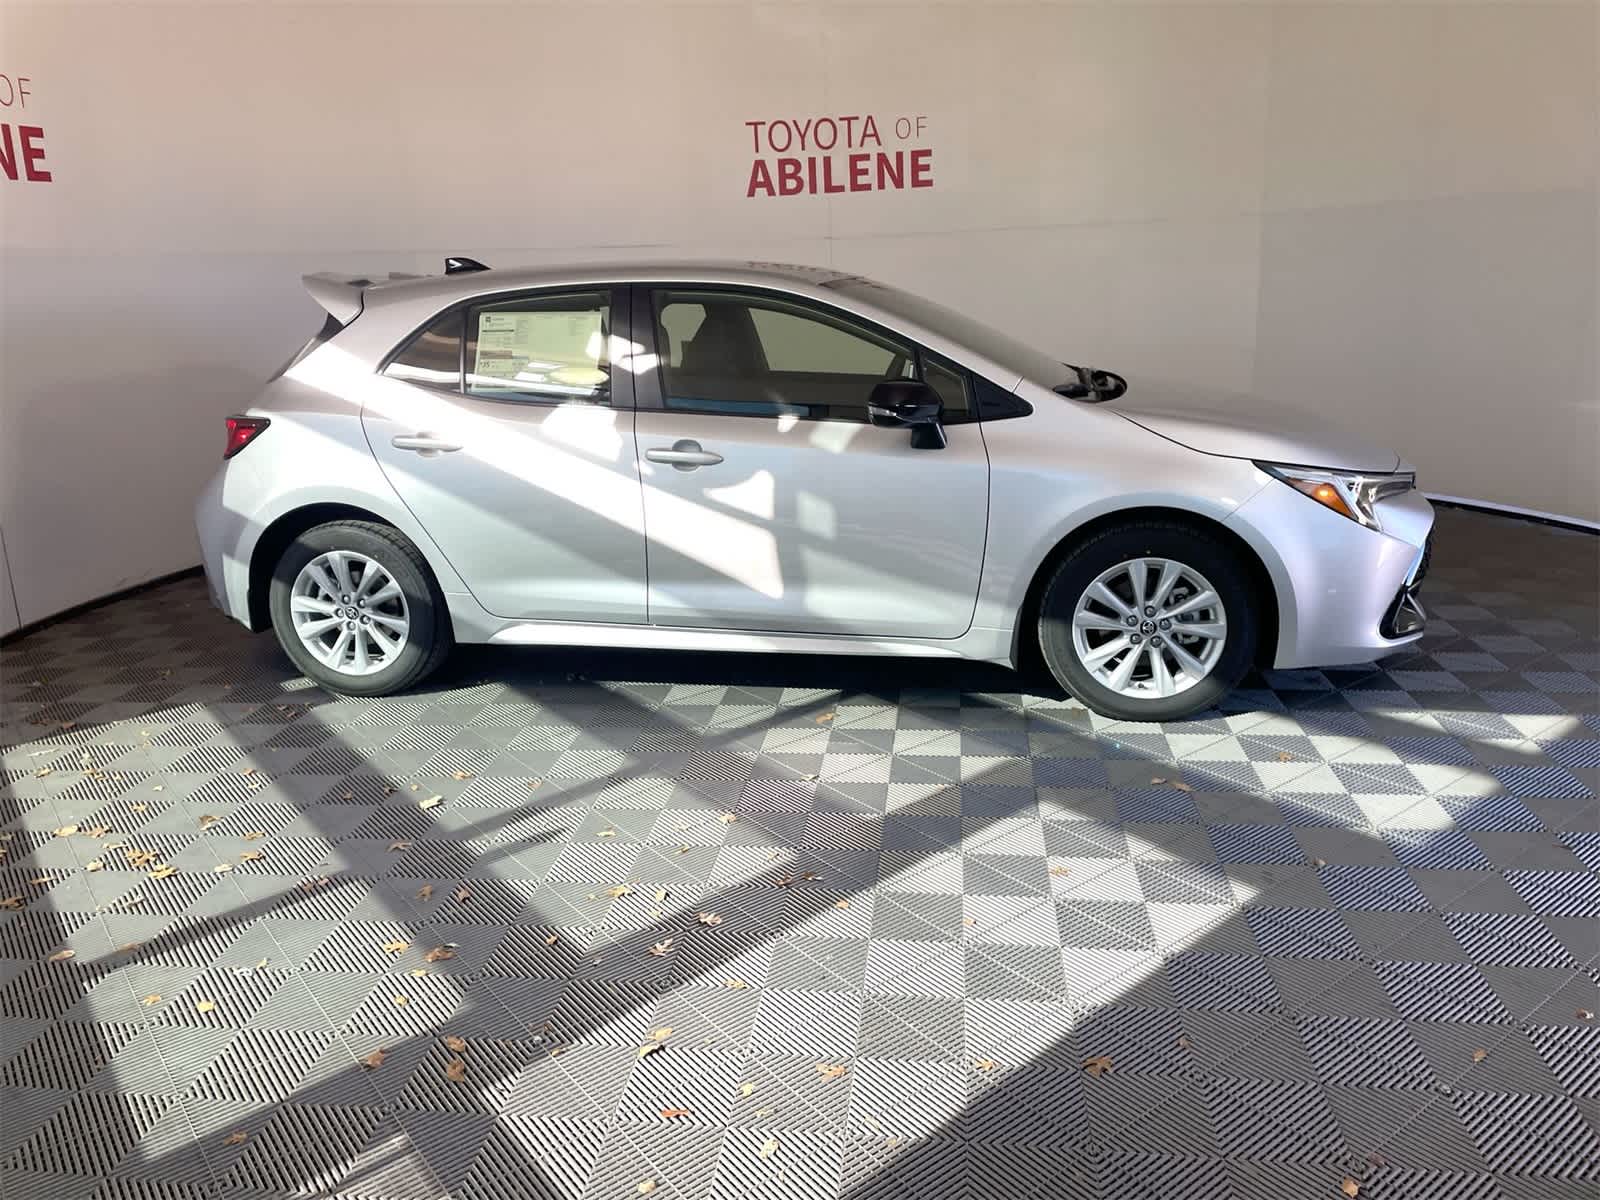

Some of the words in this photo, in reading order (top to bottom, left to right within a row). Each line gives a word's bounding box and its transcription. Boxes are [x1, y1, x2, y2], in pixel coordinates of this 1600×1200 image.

[0, 74, 31, 108] OF
[745, 115, 882, 153] TOYOTA
[896, 116, 927, 139] OF
[747, 149, 933, 197] ABILENE
